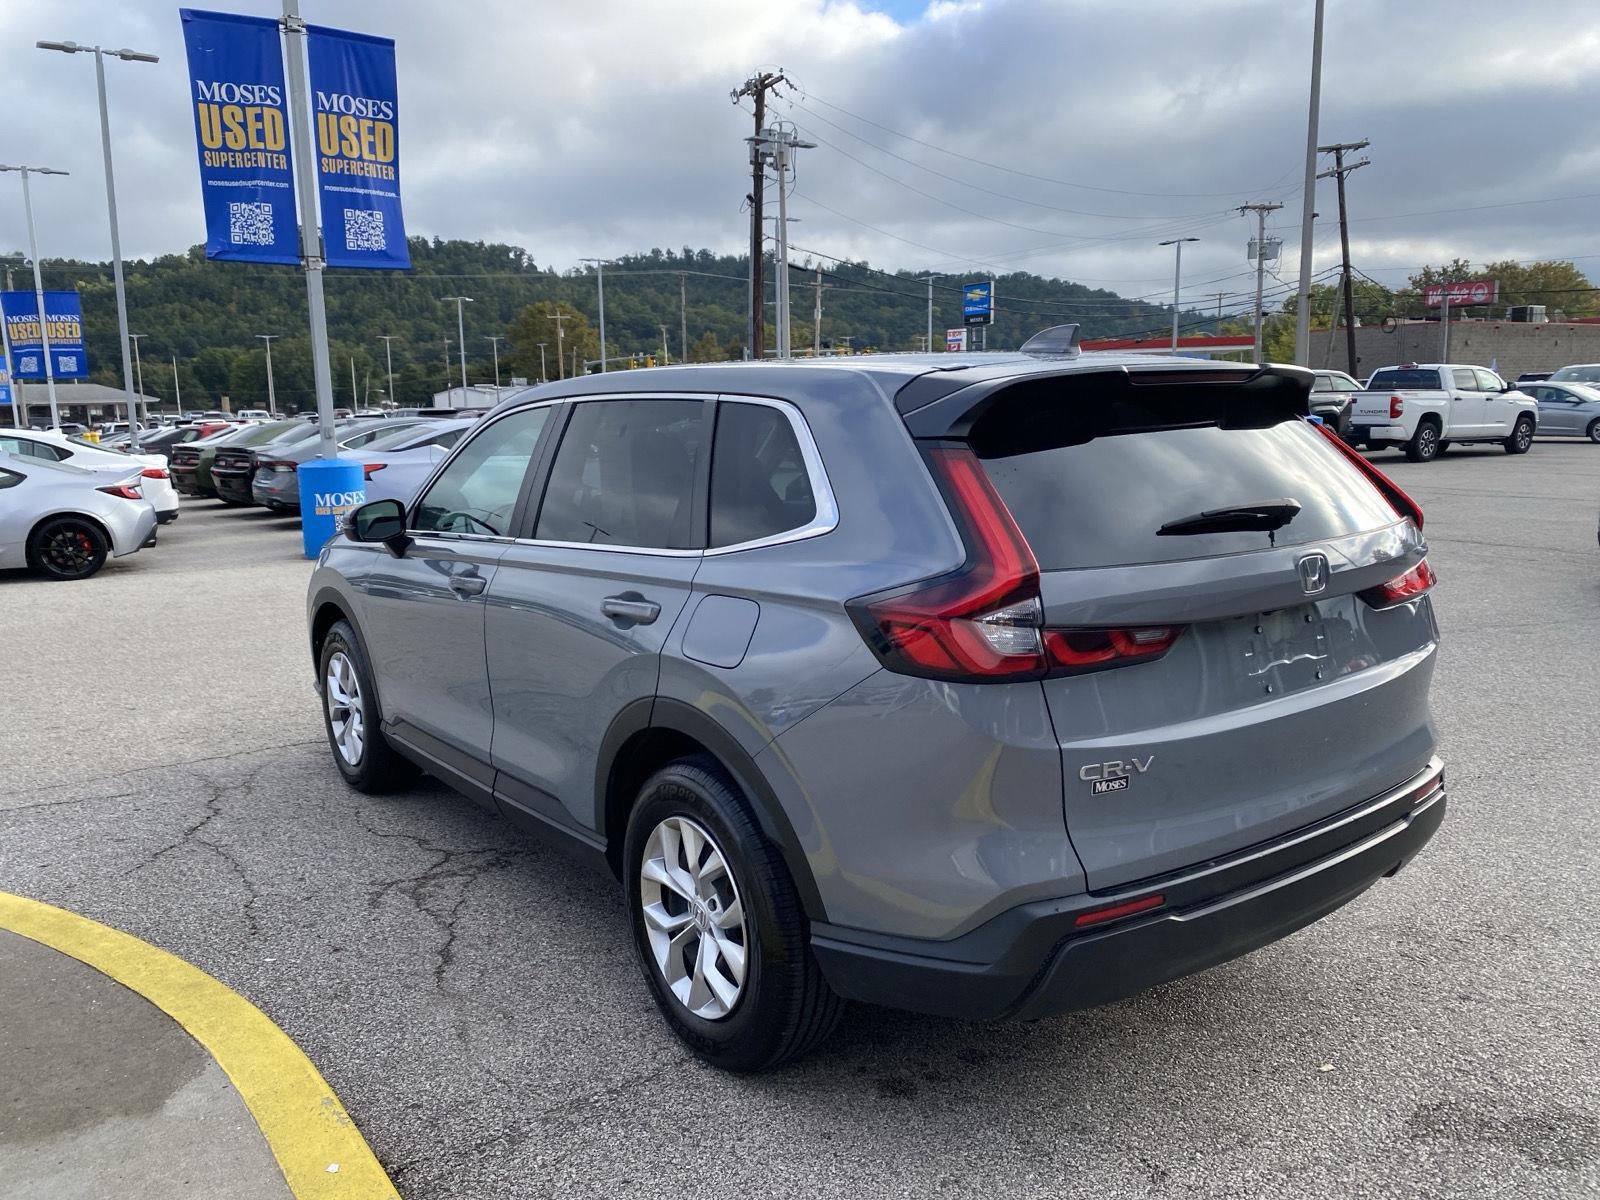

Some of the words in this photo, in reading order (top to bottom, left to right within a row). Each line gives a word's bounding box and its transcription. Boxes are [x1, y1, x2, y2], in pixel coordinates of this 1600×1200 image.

[196, 80, 281, 106] MOSES
[316, 91, 393, 120] MOSES
[198, 102, 286, 151] USED
[317, 112, 394, 163] USED
[204, 150, 287, 170] SUPERCENTER
[321, 157, 395, 181] SUPERCENTER
[207, 179, 289, 188] mosesusedsupercenter.com
[7, 314, 40, 323] MOSES
[46, 314, 80, 322] MOSES
[8, 321, 42, 340] USED
[46, 321, 81, 338] USED
[314, 490, 365, 507] MOSES
[1080, 755, 1154, 780] CR-V
[1095, 779, 1127, 793] MOSES
